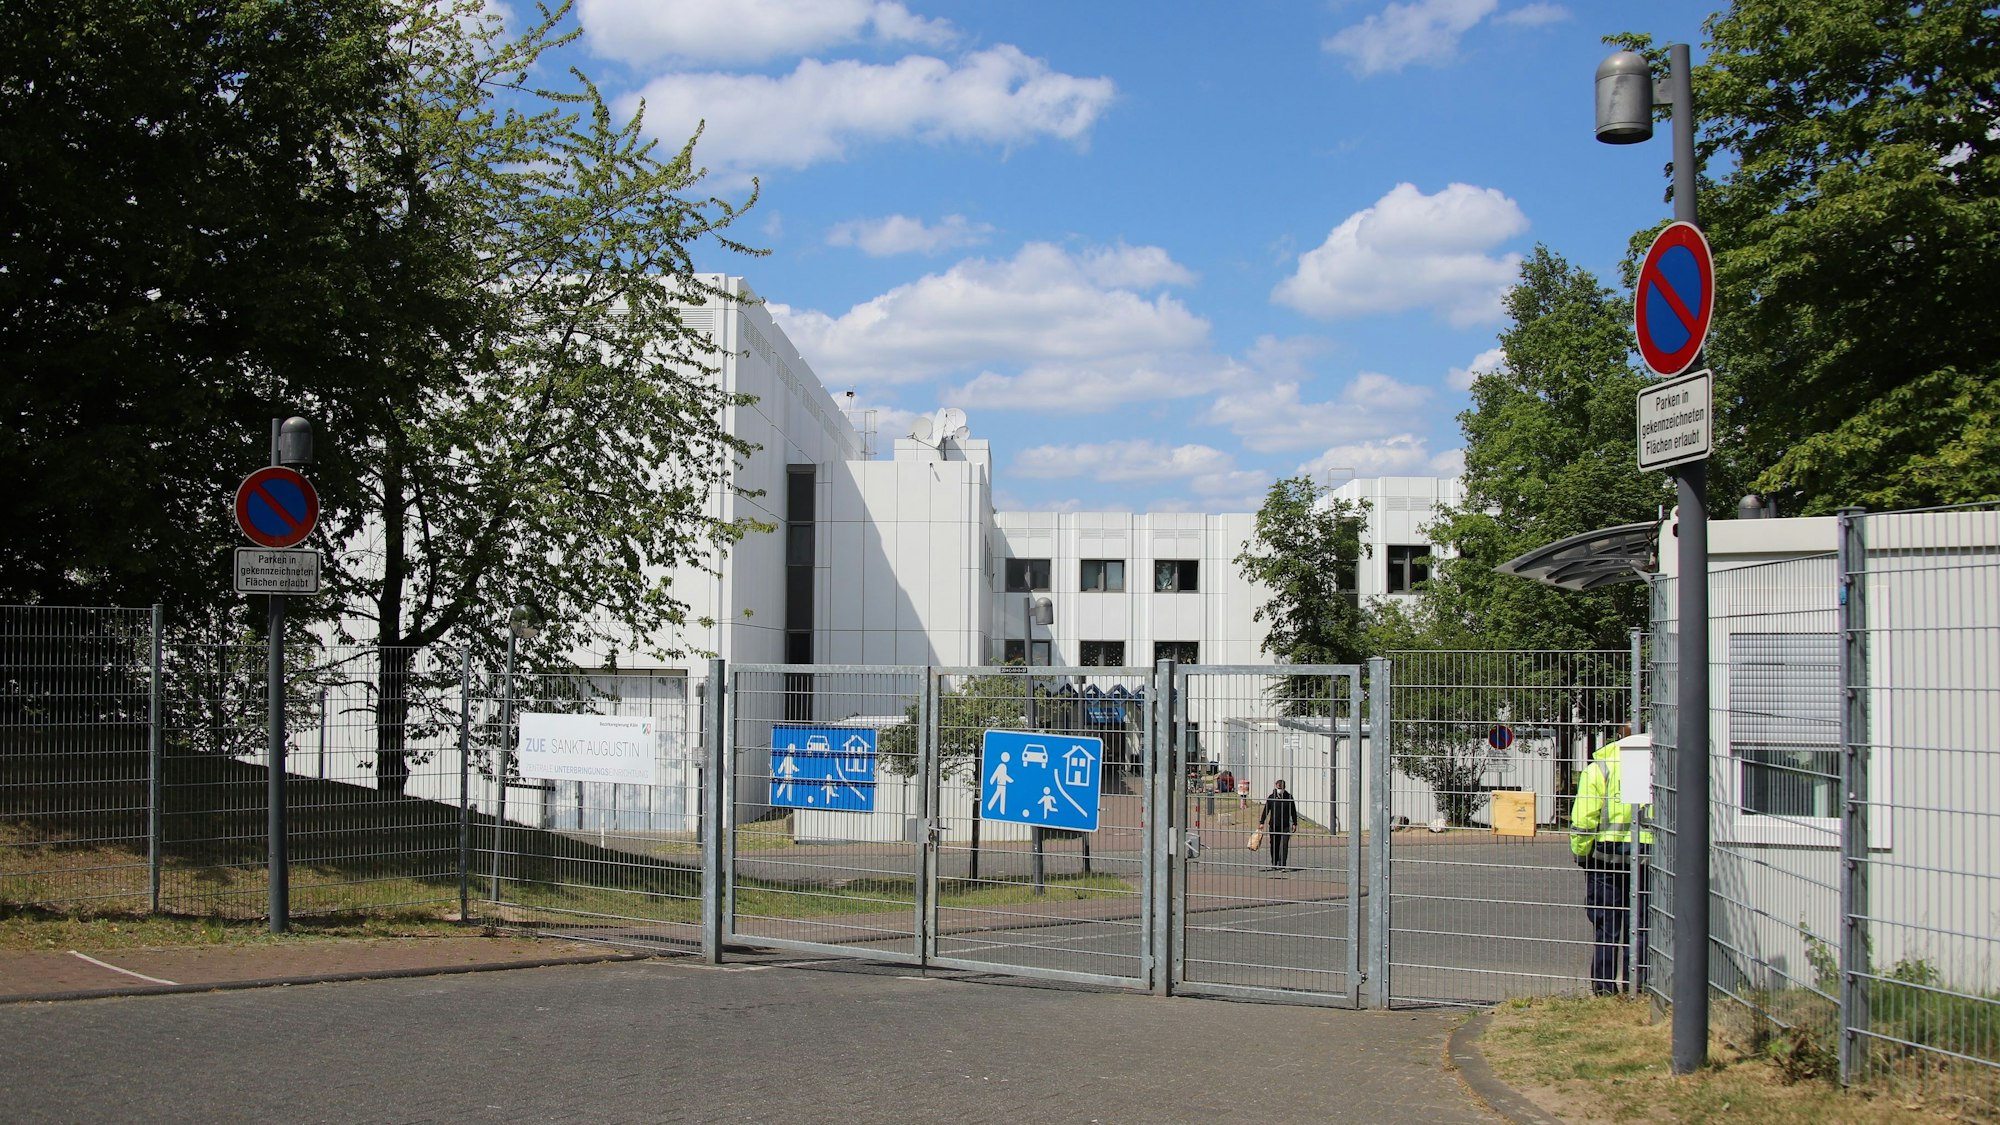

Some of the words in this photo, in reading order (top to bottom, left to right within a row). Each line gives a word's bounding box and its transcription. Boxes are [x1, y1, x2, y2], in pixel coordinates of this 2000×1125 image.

[1655, 392, 1680, 411] Parken
[1682, 389, 1689, 404] in
[1642, 407, 1704, 439] gekennzeichneten
[1646, 437, 1672, 456] Flächen
[1674, 428, 1700, 449] erlaubt
[258, 554, 287, 564] Parken
[289, 555, 296, 564] in
[240, 566, 314, 576] gekennzeichneten
[245, 577, 278, 587] Flächen
[279, 578, 309, 588] erlaubt
[525, 737, 546, 753] ZUE
[551, 738, 585, 755] SANKT
[586, 740, 640, 758] AUGUSTIN
